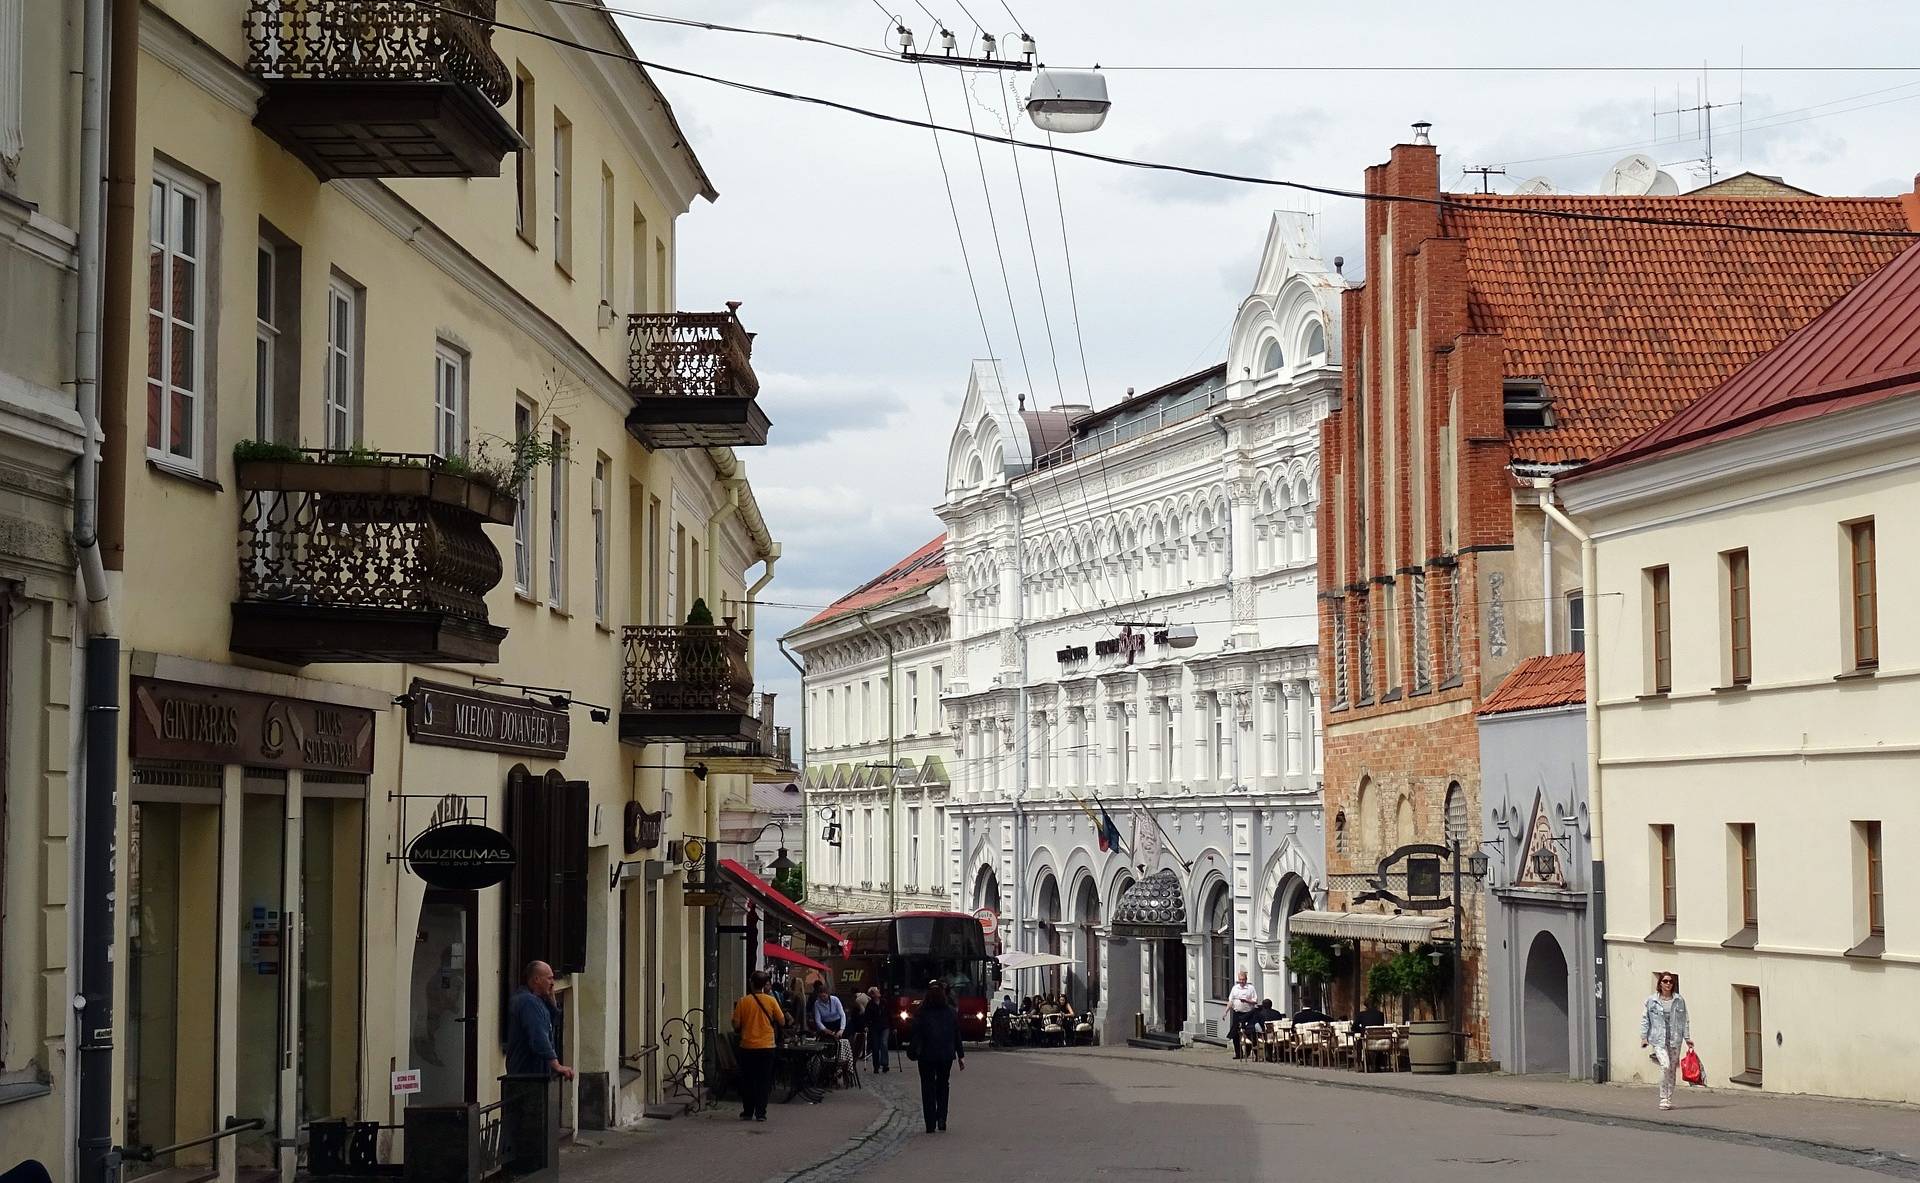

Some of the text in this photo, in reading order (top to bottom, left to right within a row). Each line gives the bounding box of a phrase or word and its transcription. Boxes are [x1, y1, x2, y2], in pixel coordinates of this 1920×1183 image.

[163, 698, 239, 745] GINTARAS
[455, 703, 495, 738] MIELOS
[305, 737, 354, 768] SUVENYRAI
[414, 849, 511, 859] MUZIKUMAS
